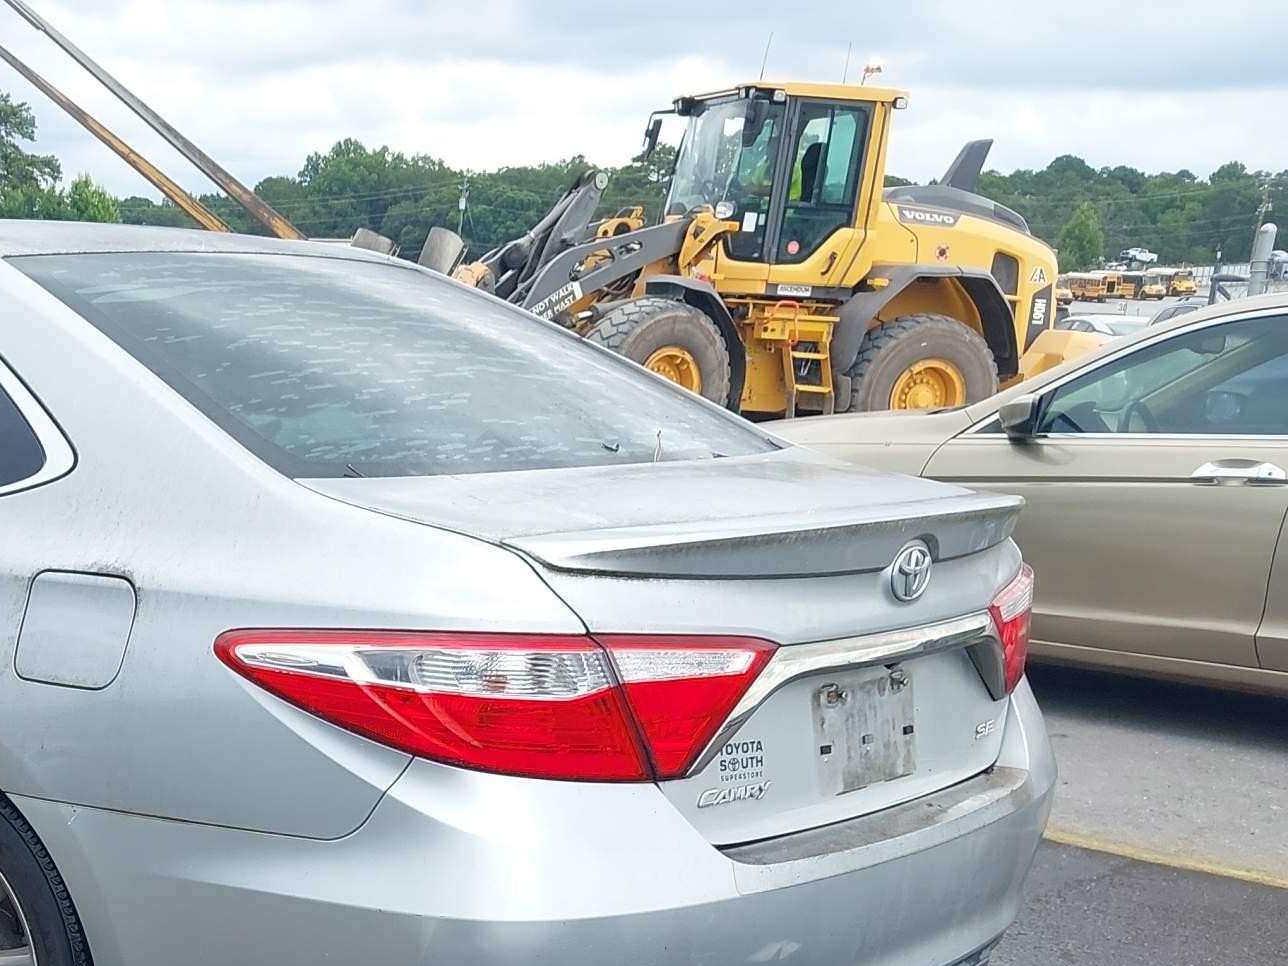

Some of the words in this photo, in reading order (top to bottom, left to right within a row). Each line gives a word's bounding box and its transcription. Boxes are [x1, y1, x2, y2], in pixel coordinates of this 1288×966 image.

[902, 210, 955, 224] VOLVO
[553, 294, 574, 314] MAST
[1031, 298, 1047, 325] L90H
[975, 719, 994, 740] SE
[720, 771, 763, 782] SUPERSTORE
[697, 780, 772, 808] CAMRY
